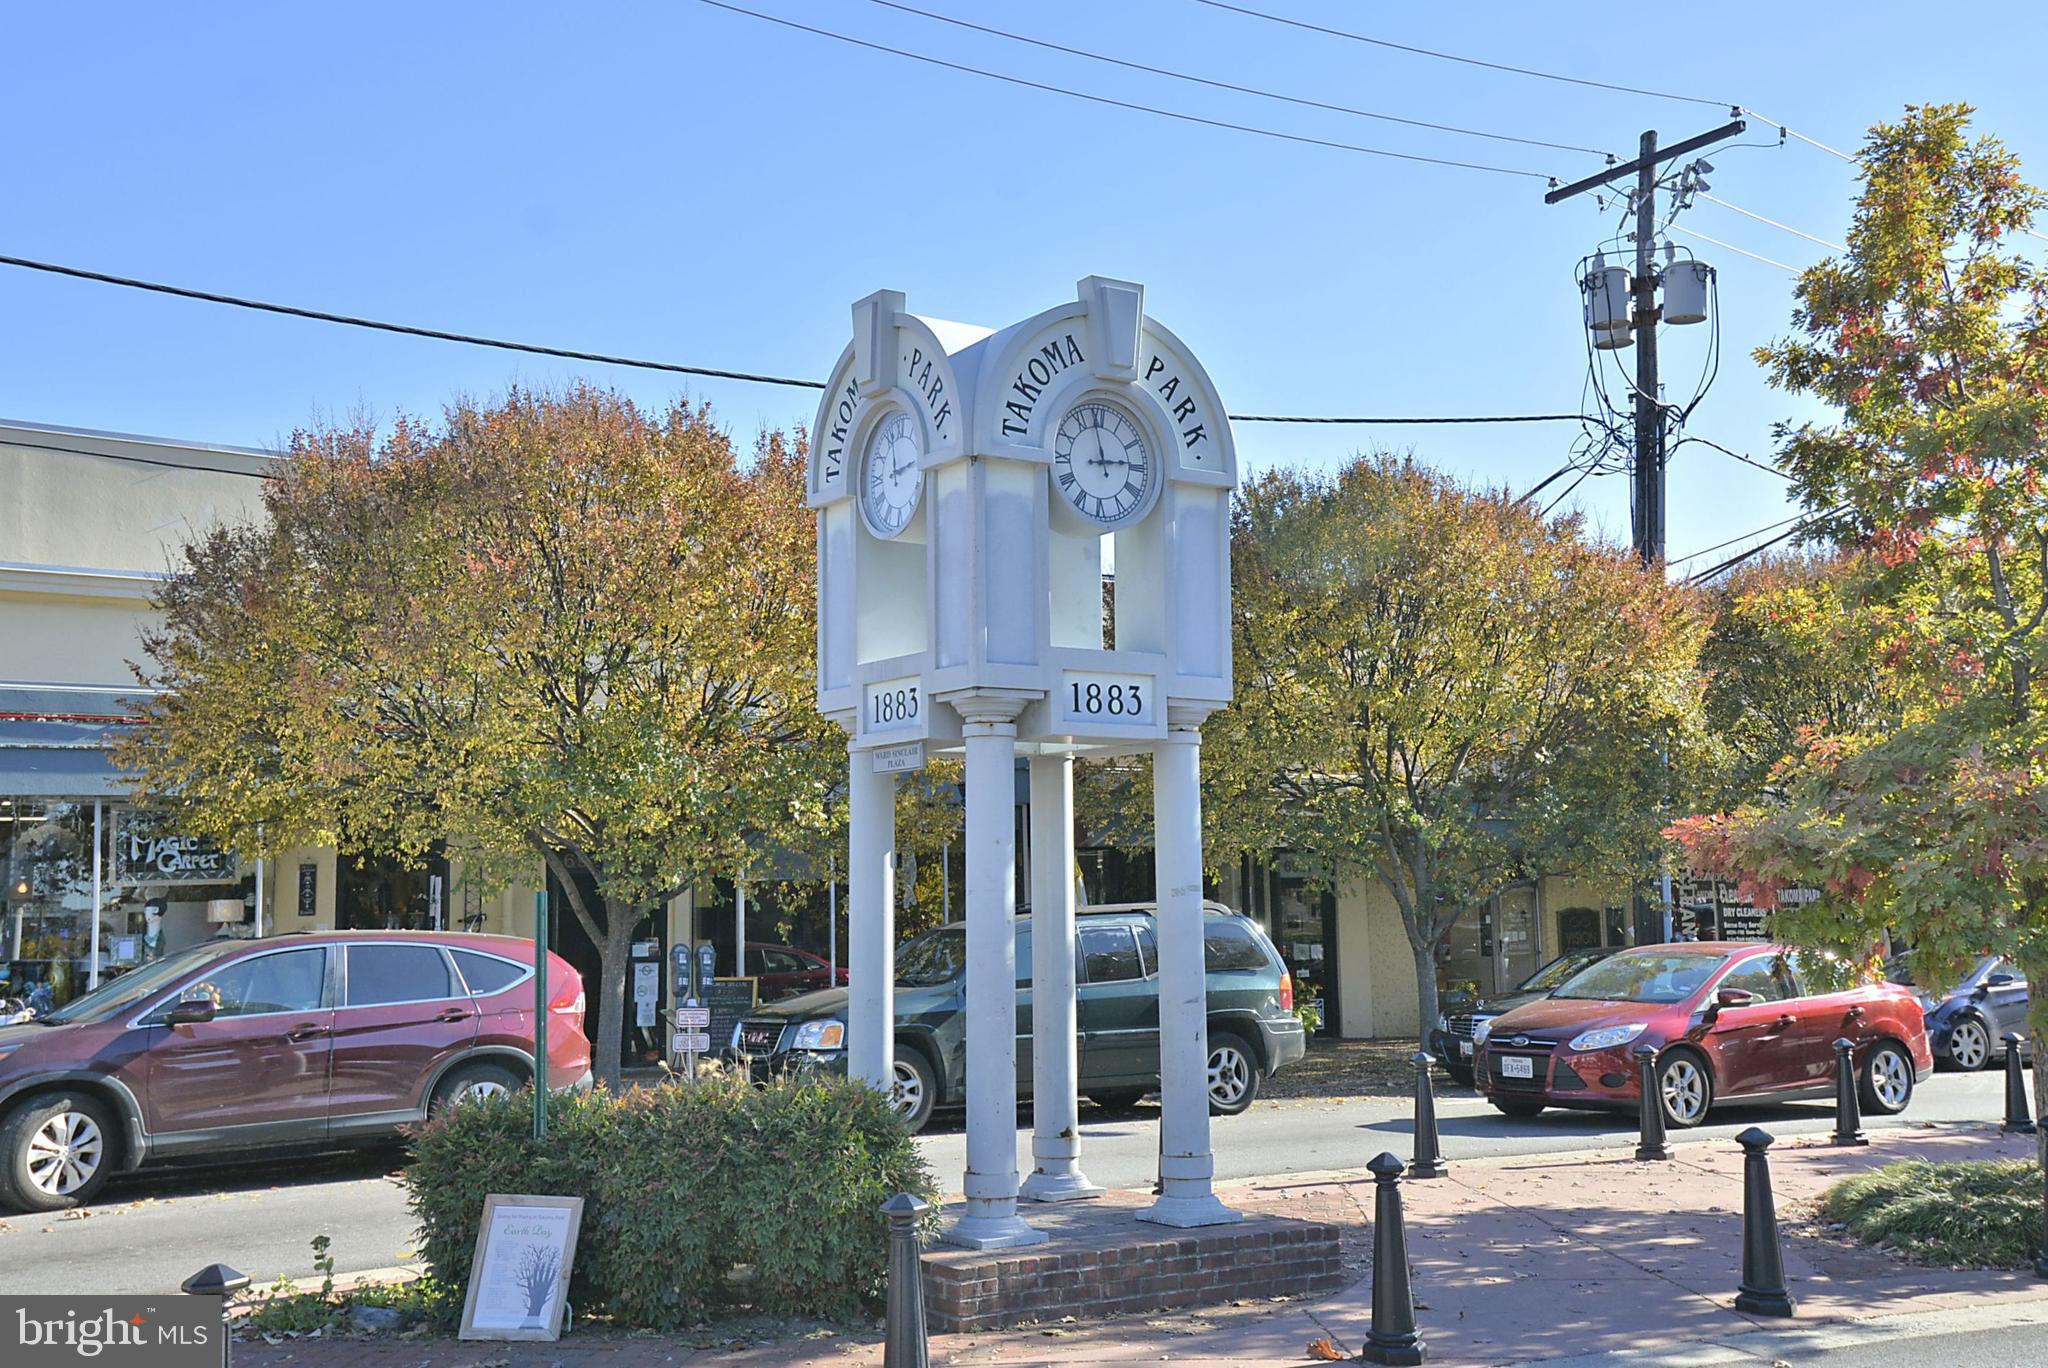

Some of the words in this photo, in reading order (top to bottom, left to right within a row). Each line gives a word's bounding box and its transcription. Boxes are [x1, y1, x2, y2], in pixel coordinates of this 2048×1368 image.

[1002, 334, 1086, 438] TAKOMA
[825, 376, 862, 484] TAKOM
[874, 687, 918, 724] 1883
[1071, 682, 1142, 716] 1883
[887, 759, 906, 769] PLAZA
[1723, 907, 1735, 917] DRY
[503, 1223, 530, 1236] Earth
[531, 1223, 552, 1238] Day
